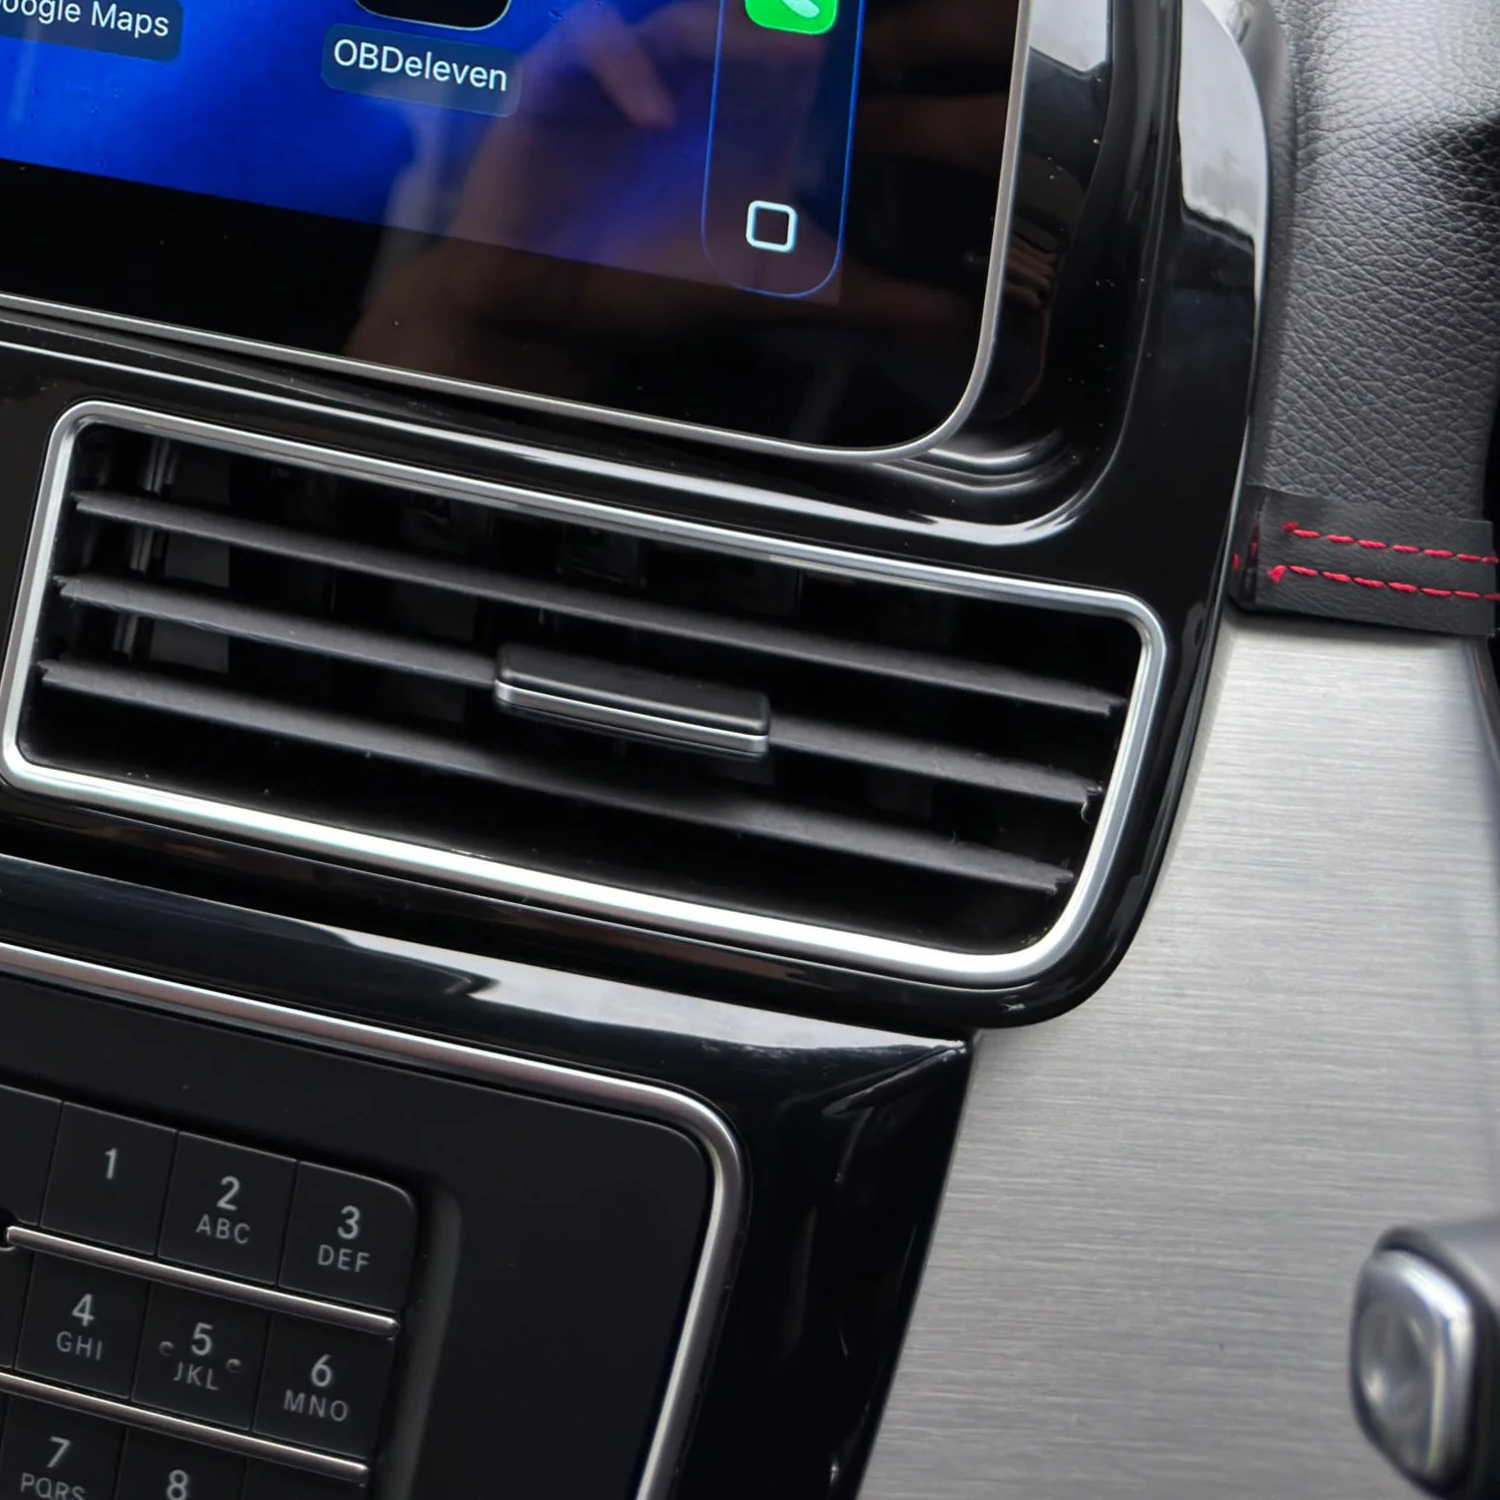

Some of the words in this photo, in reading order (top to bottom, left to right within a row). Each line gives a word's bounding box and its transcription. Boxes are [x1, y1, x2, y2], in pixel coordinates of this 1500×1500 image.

[90, 0, 170, 38] Maps
[332, 37, 508, 92] OBDeleven
[103, 1146, 119, 1181] 1
[216, 1175, 241, 1211] 2
[195, 1213, 251, 1246] ABC
[336, 1204, 362, 1241] 3
[316, 1243, 371, 1275] DEF
[71, 1292, 96, 1329] 4
[56, 1331, 103, 1361] GHI
[190, 1322, 215, 1358] 5
[172, 1361, 220, 1392] JKL
[309, 1354, 333, 1389] 6
[282, 1389, 350, 1423] MNO
[47, 1434, 72, 1470] 7
[19, 1471, 88, 1500] PQRS
[165, 1468, 190, 1500] 8
